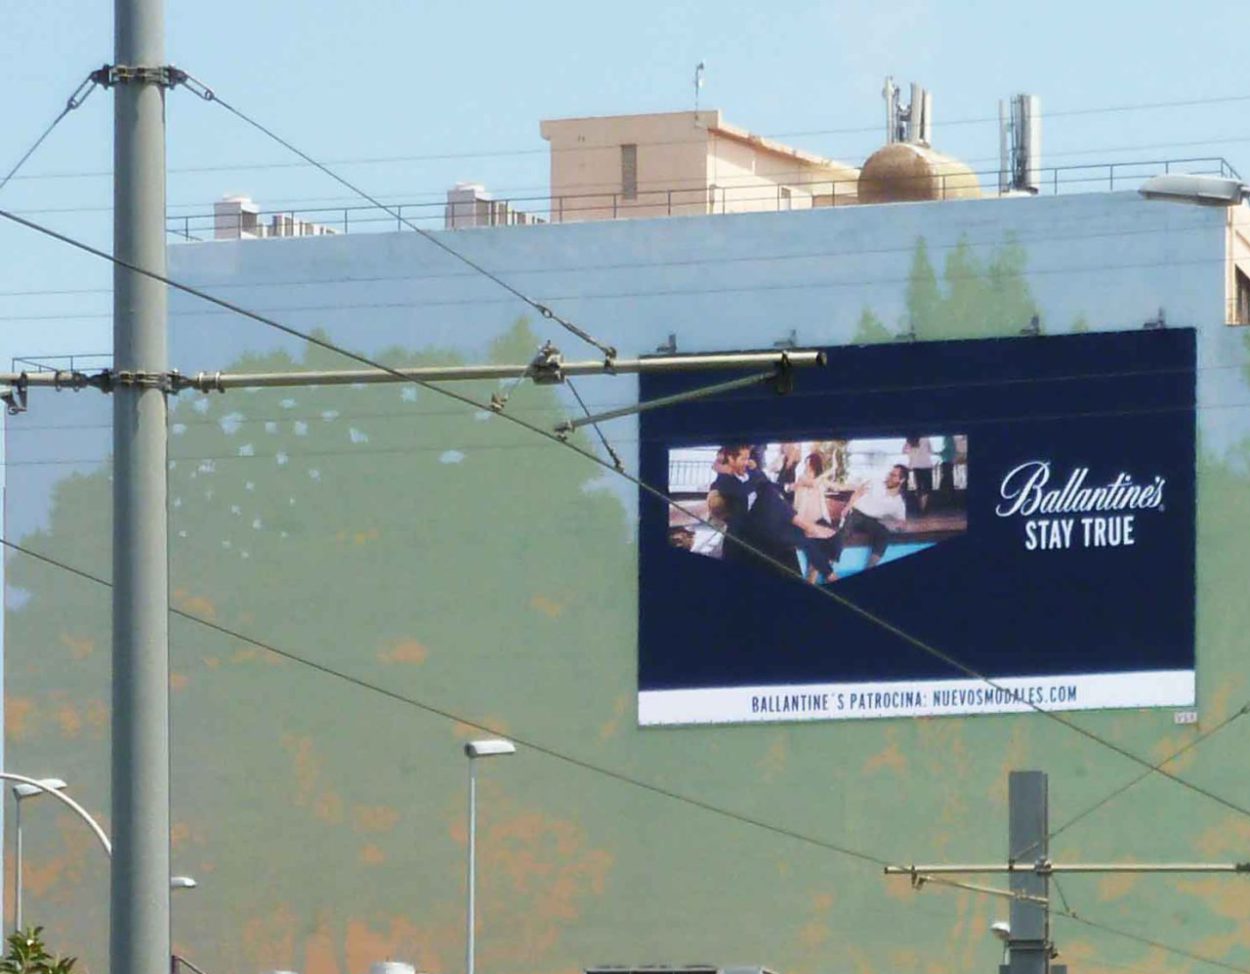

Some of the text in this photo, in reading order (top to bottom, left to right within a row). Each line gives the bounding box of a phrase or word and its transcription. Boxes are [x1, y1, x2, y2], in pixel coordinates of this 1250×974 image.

[996, 461, 1165, 517] Ballantine's
[1025, 515, 1134, 550] STAY TRUE
[932, 685, 1077, 707] NUEVOSMODALES.COM
